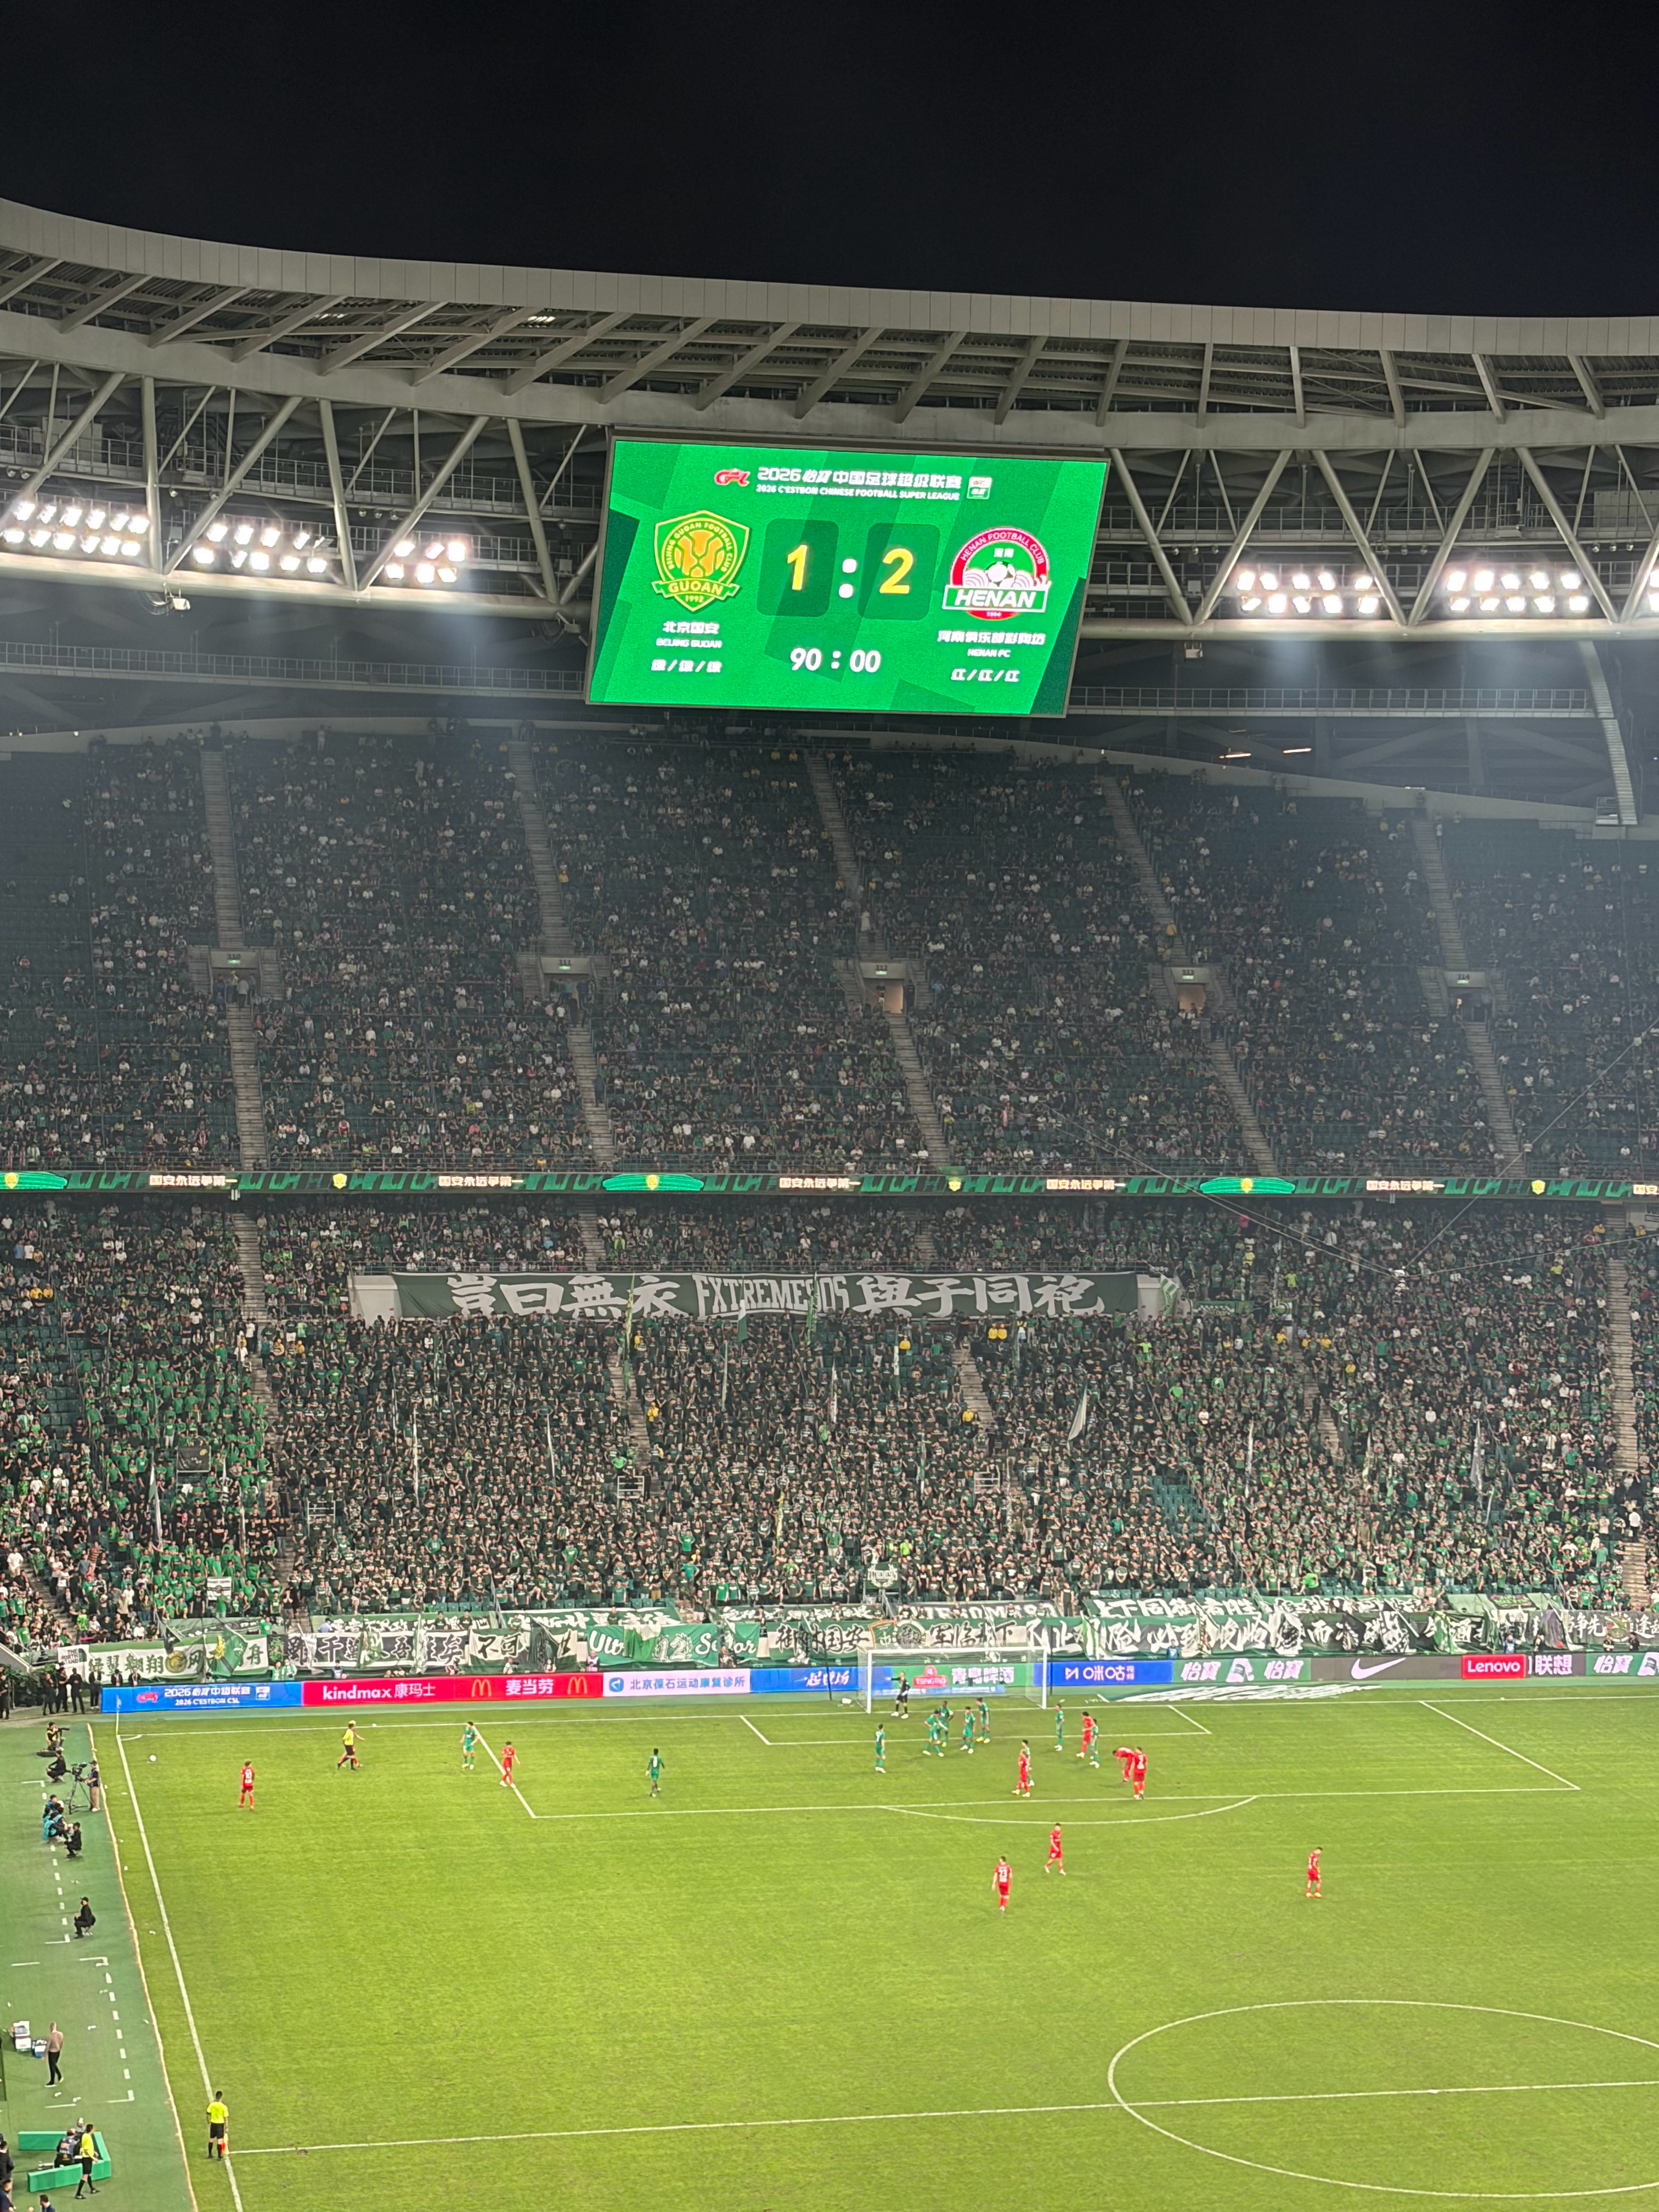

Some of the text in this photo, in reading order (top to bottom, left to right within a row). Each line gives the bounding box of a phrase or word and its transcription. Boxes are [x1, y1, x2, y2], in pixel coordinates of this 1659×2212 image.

[756, 484, 776, 493] 2026
[819, 487, 854, 496] CHINESE
[855, 489, 898, 499] FOOTBALL
[899, 491, 926, 499] SUPER
[927, 492, 960, 500] LEAGUE
[665, 522, 733, 572] BEIJING GUOAN FOOTBALL CLUB
[960, 532, 1045, 565] HENAN FOOTBALL CLUB
[668, 580, 724, 595] GUOAN
[955, 589, 1036, 608] HENAN
[662, 620, 720, 634] 北京国安
[691, 640, 723, 648] GUOAN
[967, 648, 1012, 657] HENAN FC
[1633, 1184, 1659, 1195] 国安
[1467, 1654, 1573, 1675] Lenovo 联想
[505, 1678, 554, 1695] 麦当劳
[916, 1677, 947, 1686] TSINGTAO
[323, 1683, 436, 1700] kindmax 康玛士
